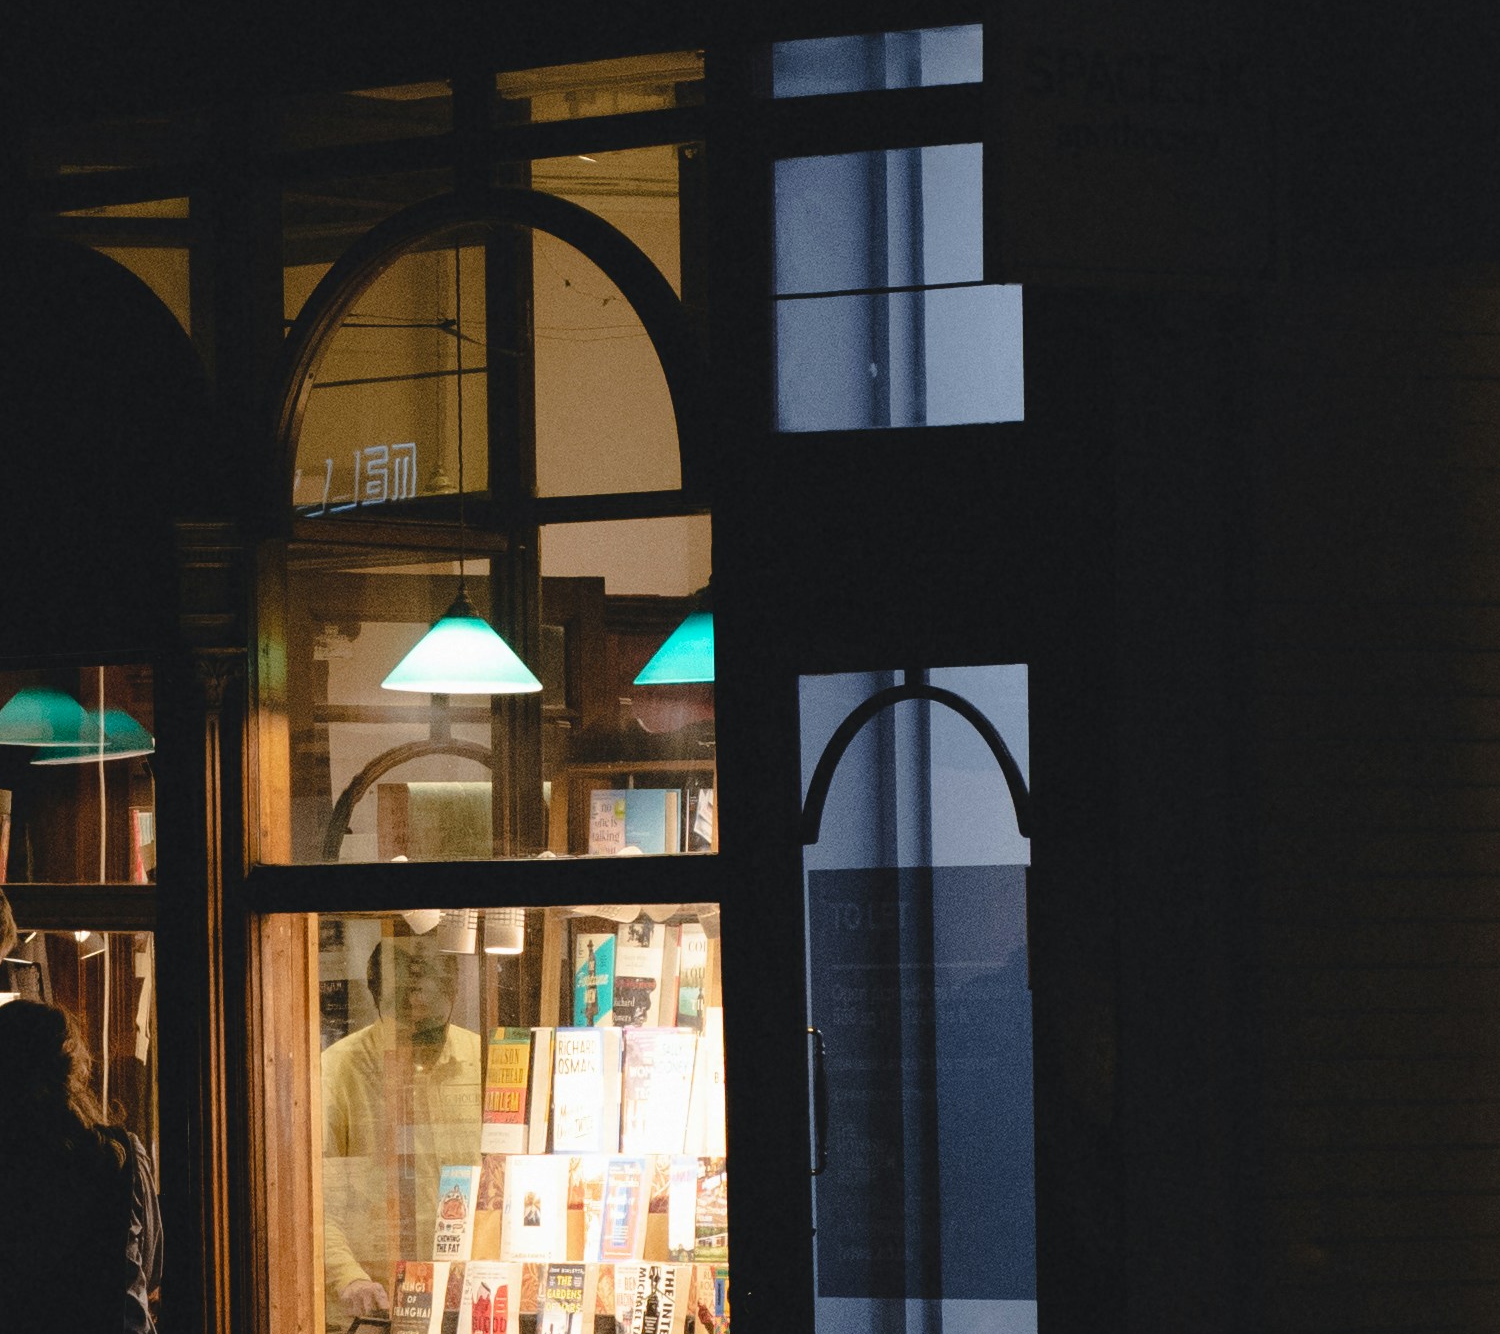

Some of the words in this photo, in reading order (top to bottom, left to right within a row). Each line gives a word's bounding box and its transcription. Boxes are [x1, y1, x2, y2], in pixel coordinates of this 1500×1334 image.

[557, 1058, 596, 1075] OSMAN
[447, 1243, 461, 1253] FAT
[556, 1275, 573, 1286] THE
[664, 1269, 676, 1297] THE
[407, 1295, 417, 1304] OF
[634, 1266, 647, 1321] MICHAEL
